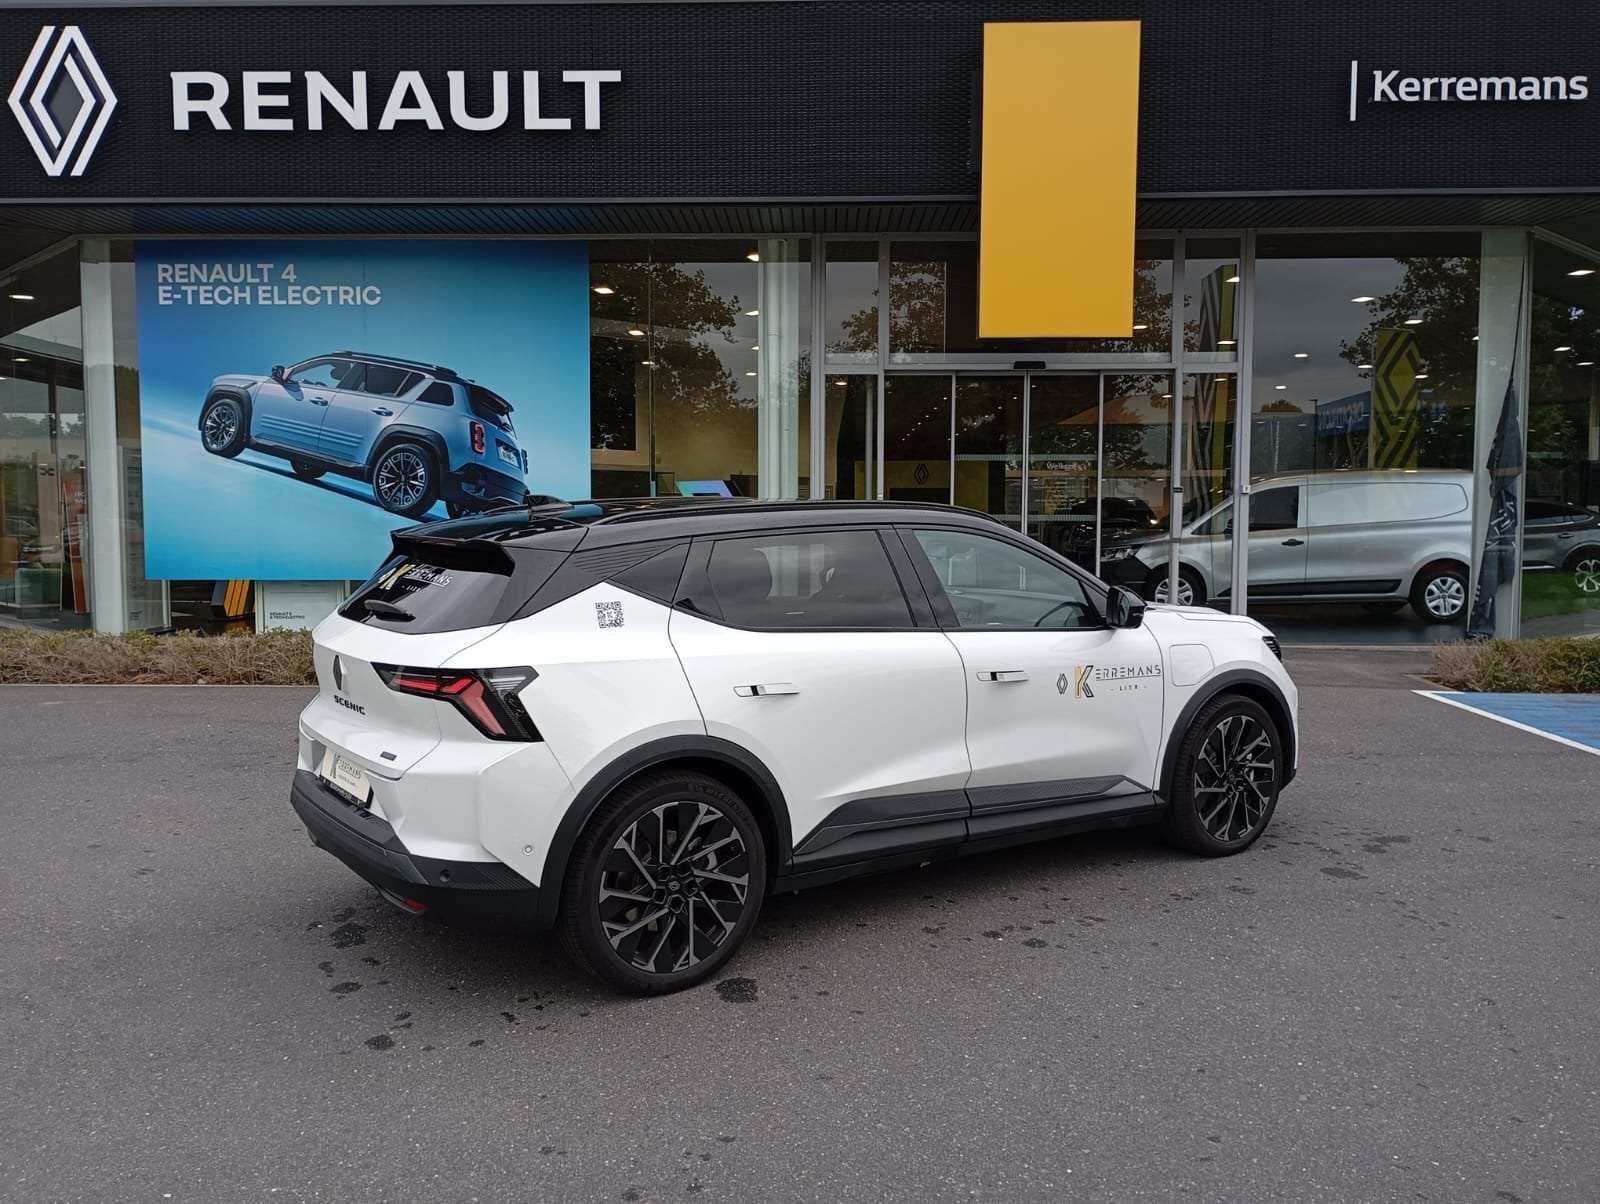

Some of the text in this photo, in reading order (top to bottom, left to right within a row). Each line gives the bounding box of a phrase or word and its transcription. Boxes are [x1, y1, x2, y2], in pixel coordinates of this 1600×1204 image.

[1373, 69, 1589, 102] Kerremans
[170, 70, 622, 131] RENAULT
[157, 263, 297, 283] RENAULT 4
[158, 285, 382, 306] E-TECH ELECTRIC
[1074, 664, 1161, 700] KERREMANS
[333, 694, 366, 716] SCENIC
